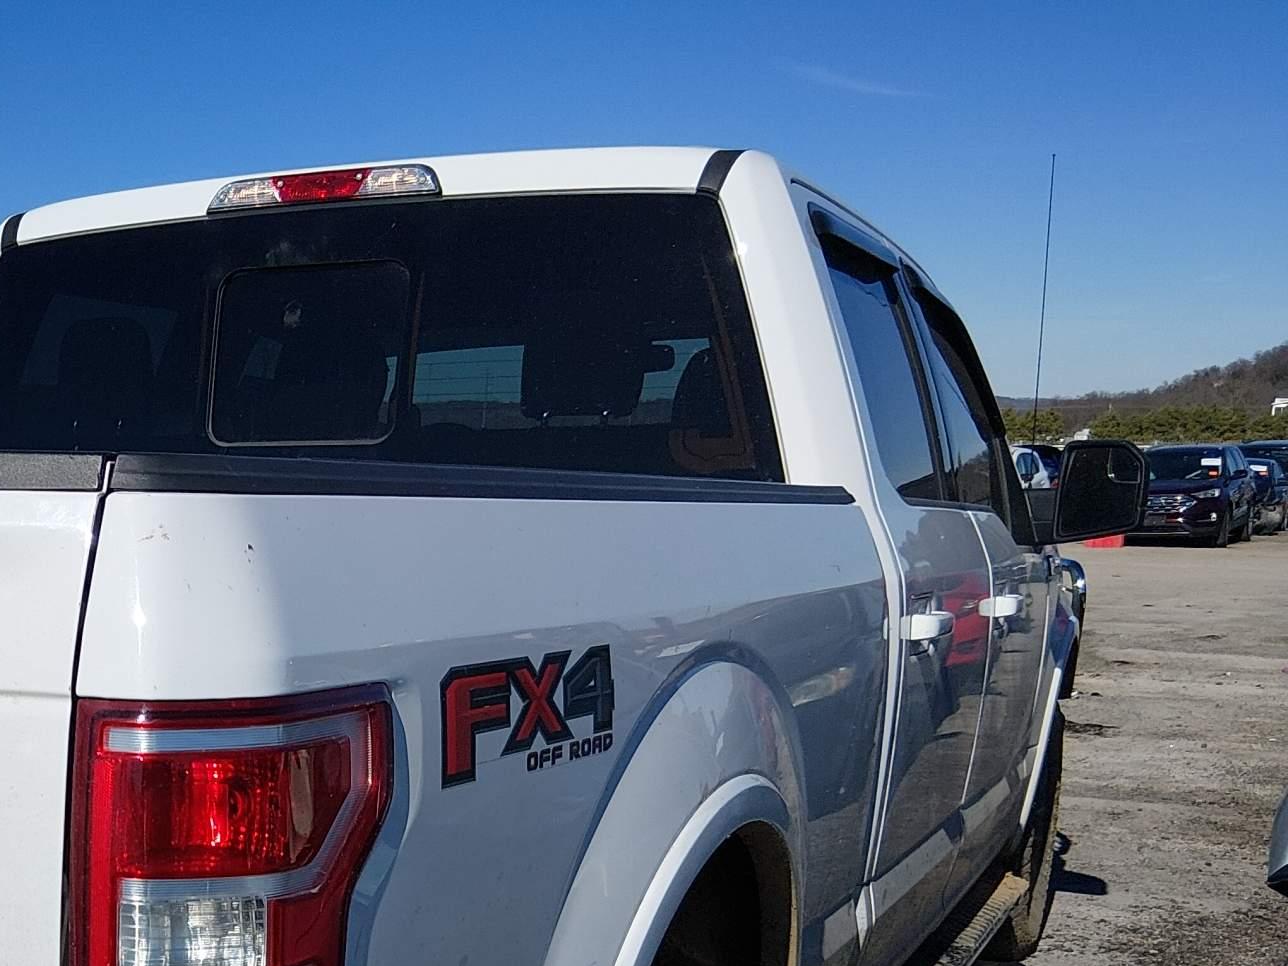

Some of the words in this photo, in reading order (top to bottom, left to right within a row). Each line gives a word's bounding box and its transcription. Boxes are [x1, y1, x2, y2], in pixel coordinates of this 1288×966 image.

[440, 644, 614, 790] FX4
[527, 749, 563, 772] OFF
[569, 733, 614, 761] ROAD
